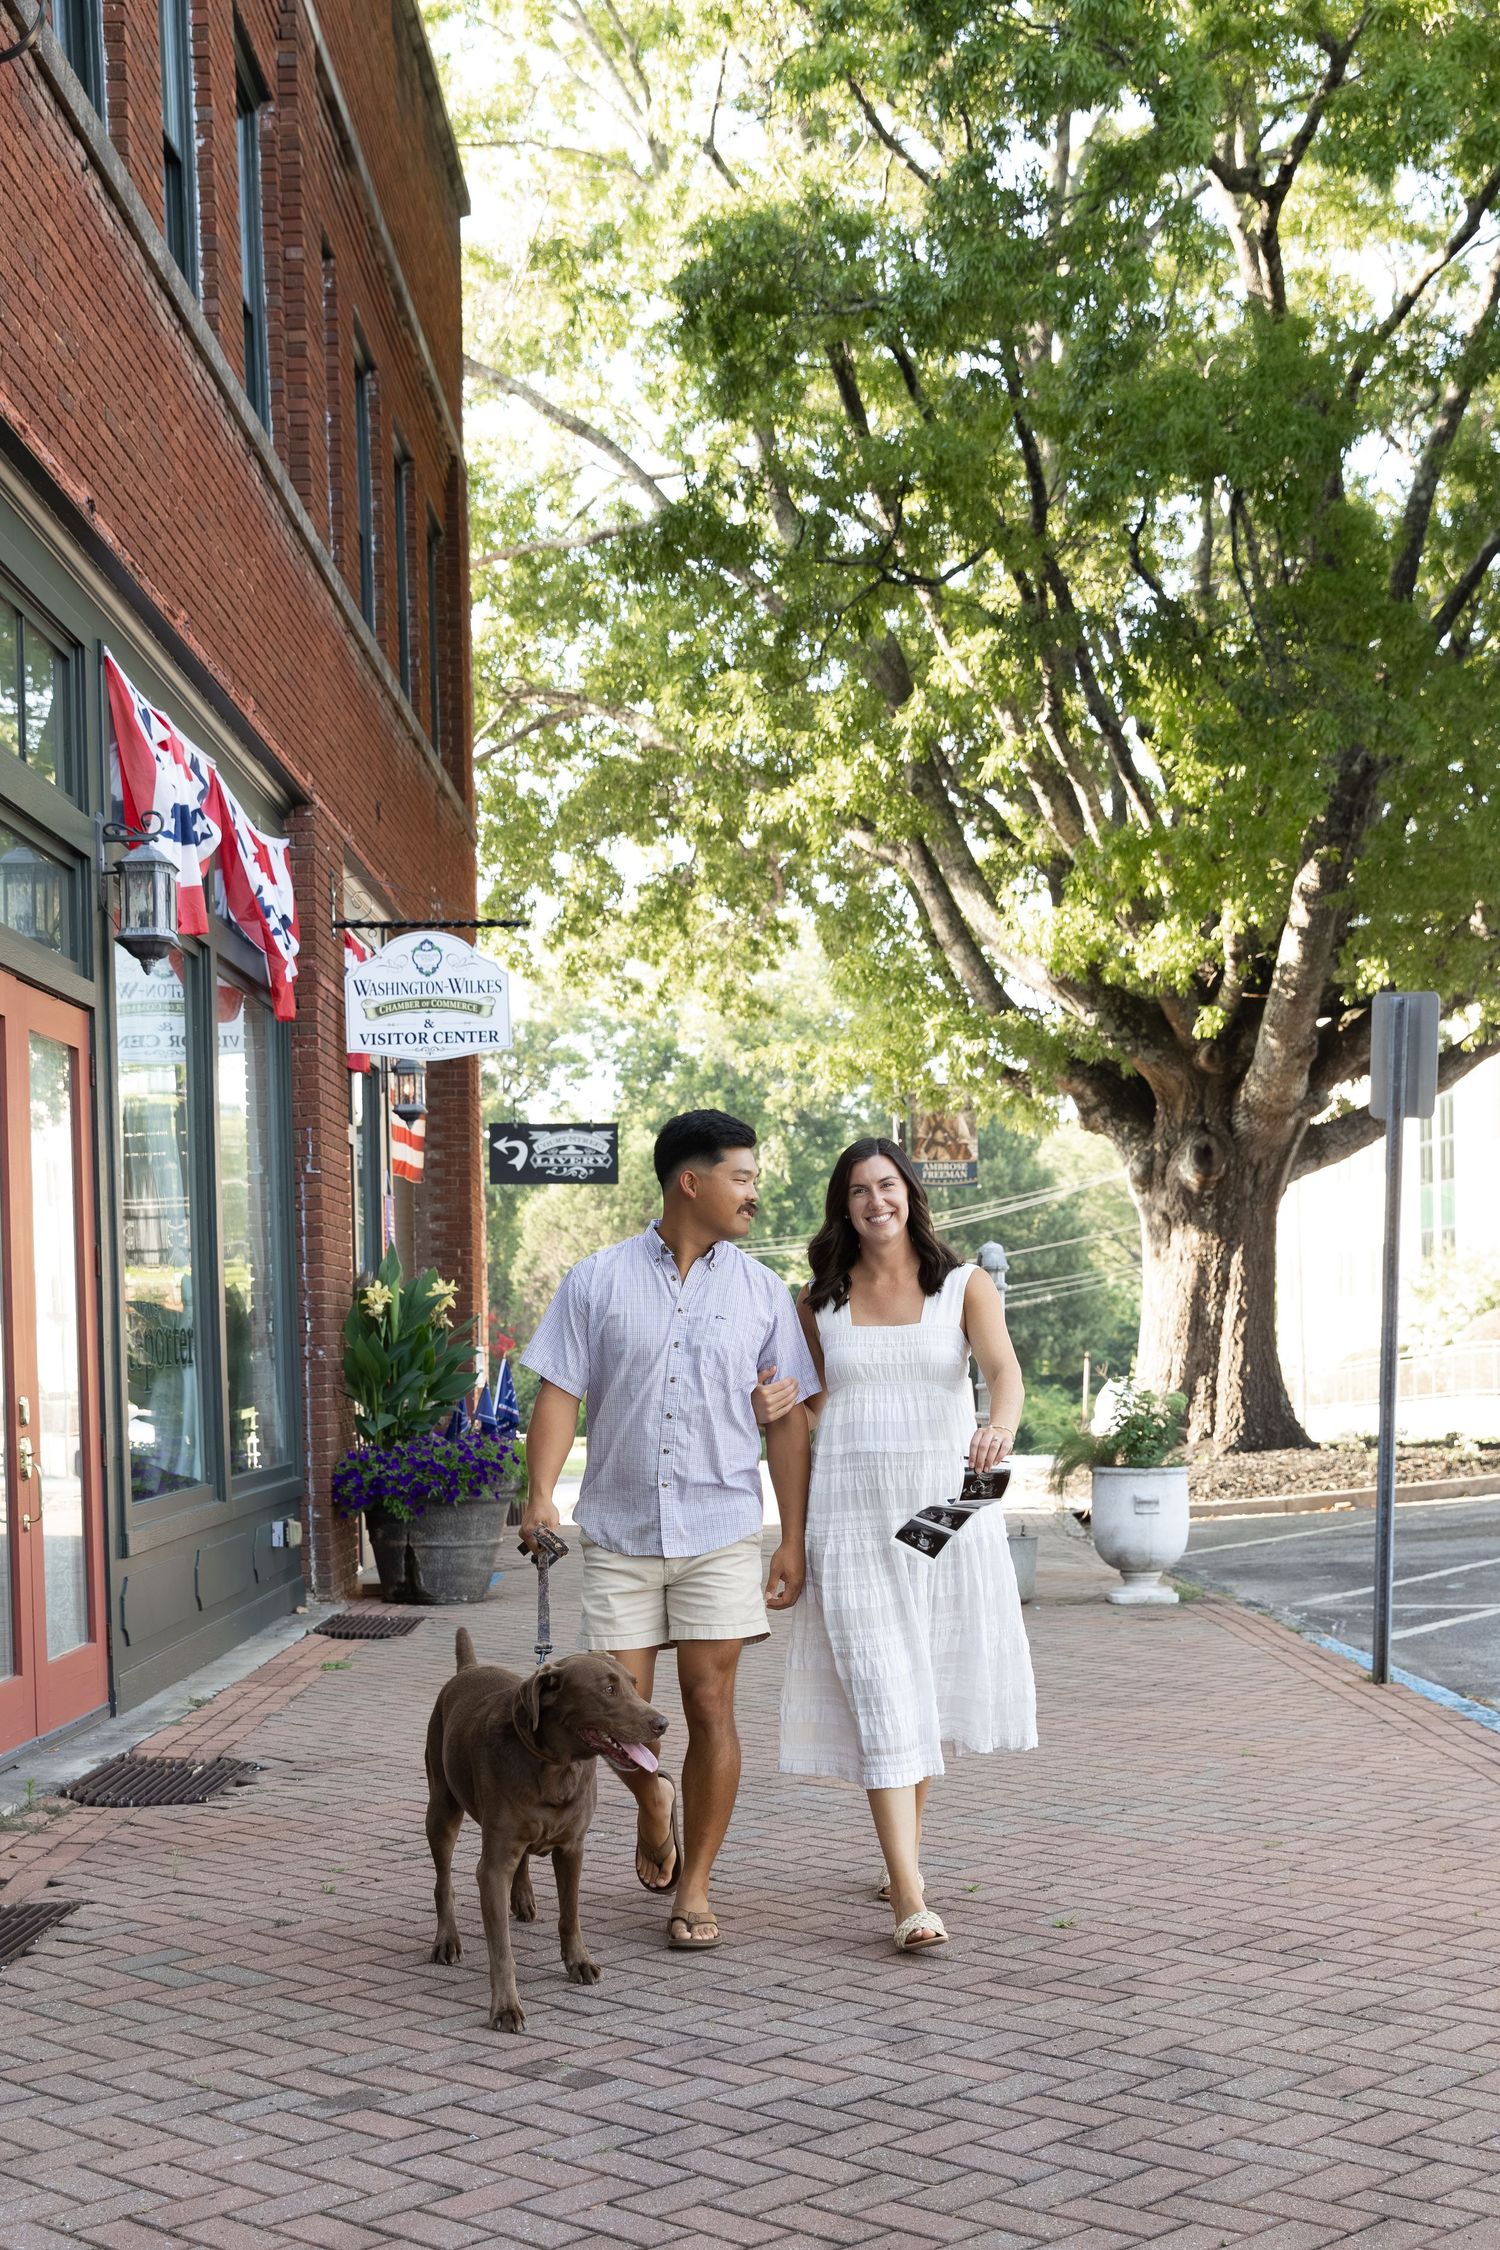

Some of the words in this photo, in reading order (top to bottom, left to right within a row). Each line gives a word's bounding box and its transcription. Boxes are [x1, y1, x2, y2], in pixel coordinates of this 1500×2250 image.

[379, 1000, 421, 1014] CHAMBER
[431, 999, 478, 1013] COMMERCE
[423, 1018, 435, 1029] &
[360, 1032, 428, 1046] VISITOR
[433, 1030, 500, 1044] CENTER
[536, 1156, 607, 1165] LIVERY
[922, 1162, 969, 1171] AMBROSE
[922, 1170, 968, 1179] FREEMAN
